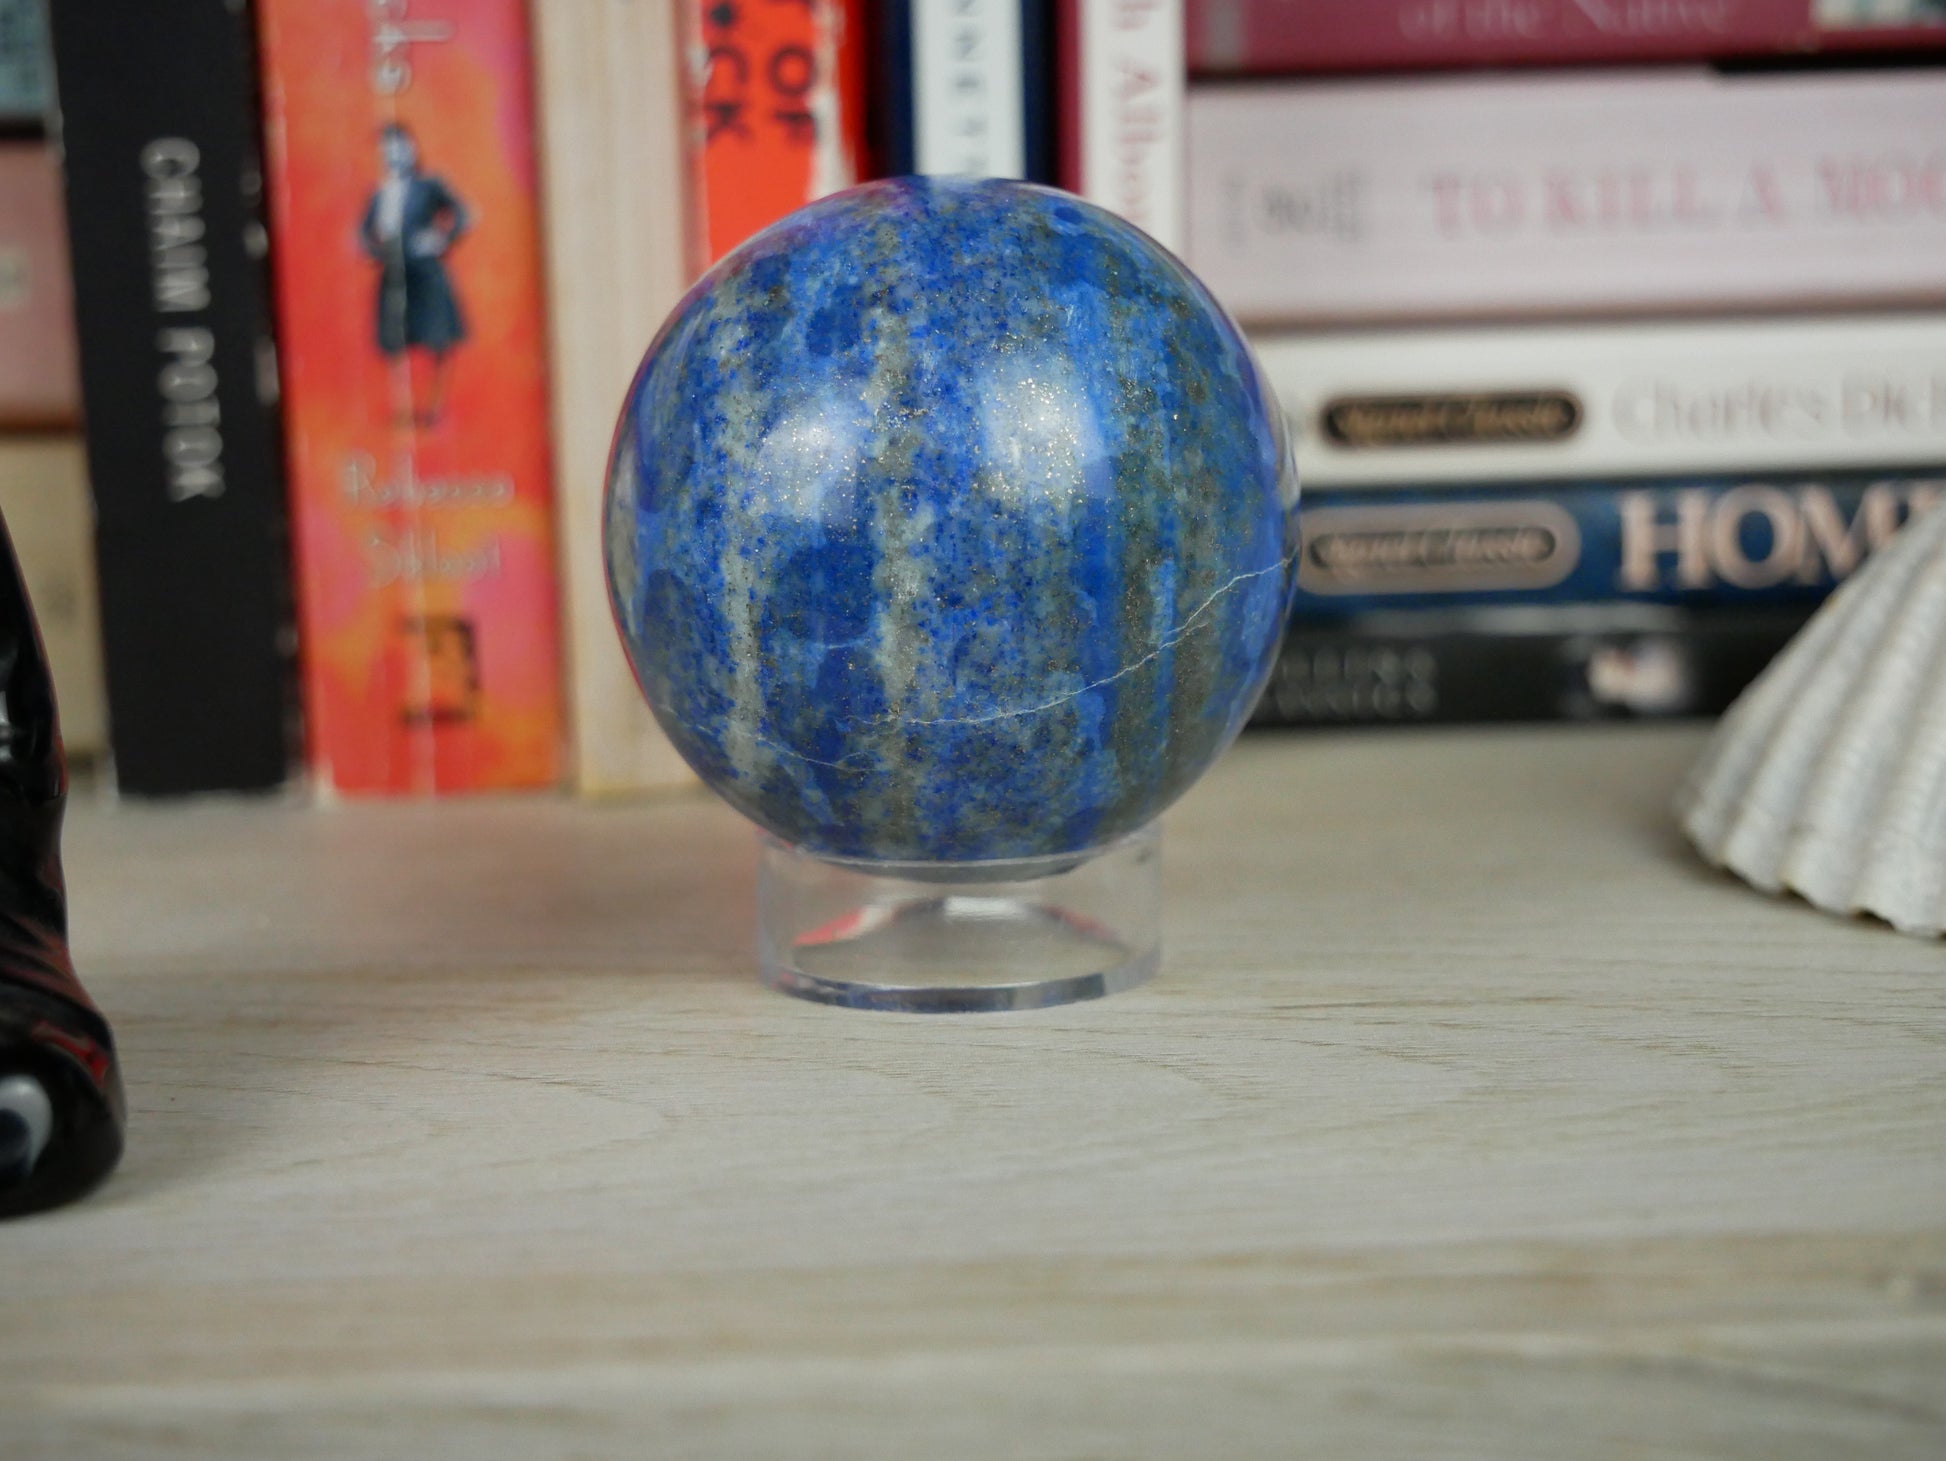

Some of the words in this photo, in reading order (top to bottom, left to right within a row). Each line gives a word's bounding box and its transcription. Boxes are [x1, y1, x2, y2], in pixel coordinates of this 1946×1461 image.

[140, 136, 211, 312] CHAIM
[1428, 170, 1522, 238] TO
[1544, 163, 1703, 232] KILL
[1738, 162, 1785, 228] A
[156, 326, 226, 502] POTOK
[1615, 482, 1946, 592] HOM
